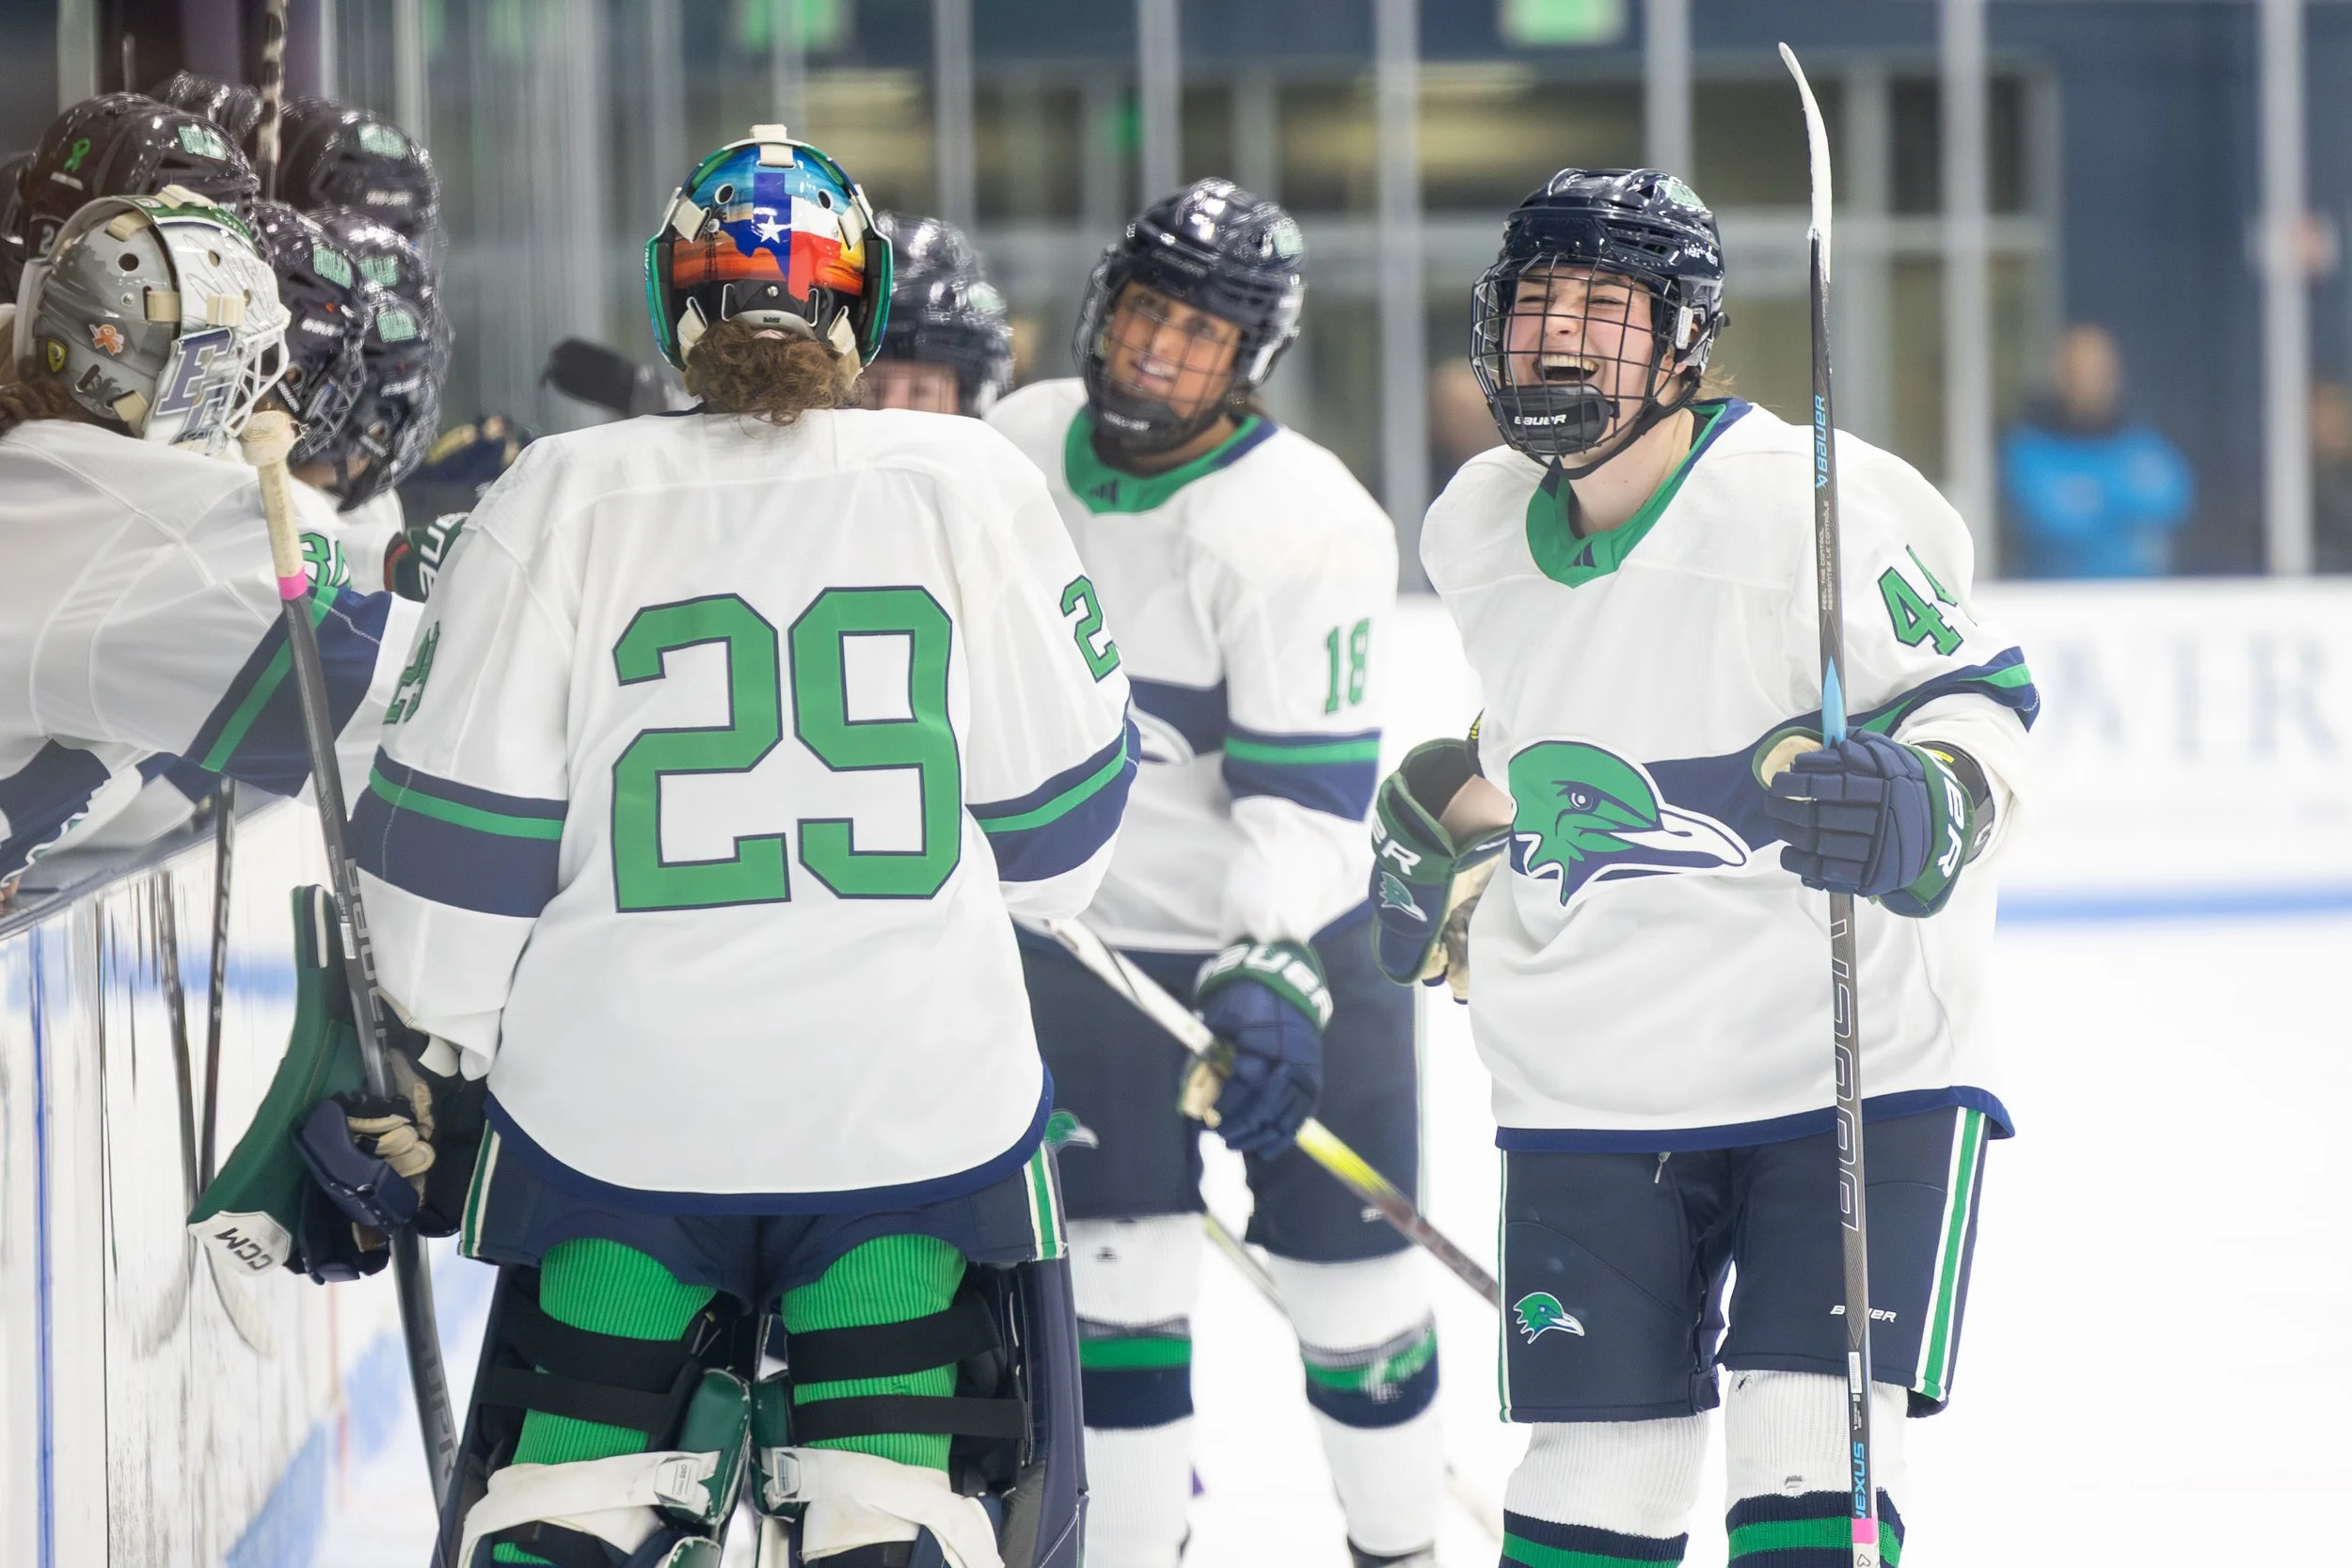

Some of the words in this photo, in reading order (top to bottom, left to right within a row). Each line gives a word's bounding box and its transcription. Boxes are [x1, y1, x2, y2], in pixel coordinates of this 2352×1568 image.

[1514, 414, 1567, 426] BAUER
[1815, 395, 1828, 473] BAUER
[1325, 617, 1370, 715] 18
[613, 585, 961, 911] 29
[212, 1225, 275, 1272] CCM
[1829, 1305, 1897, 1323] BER
